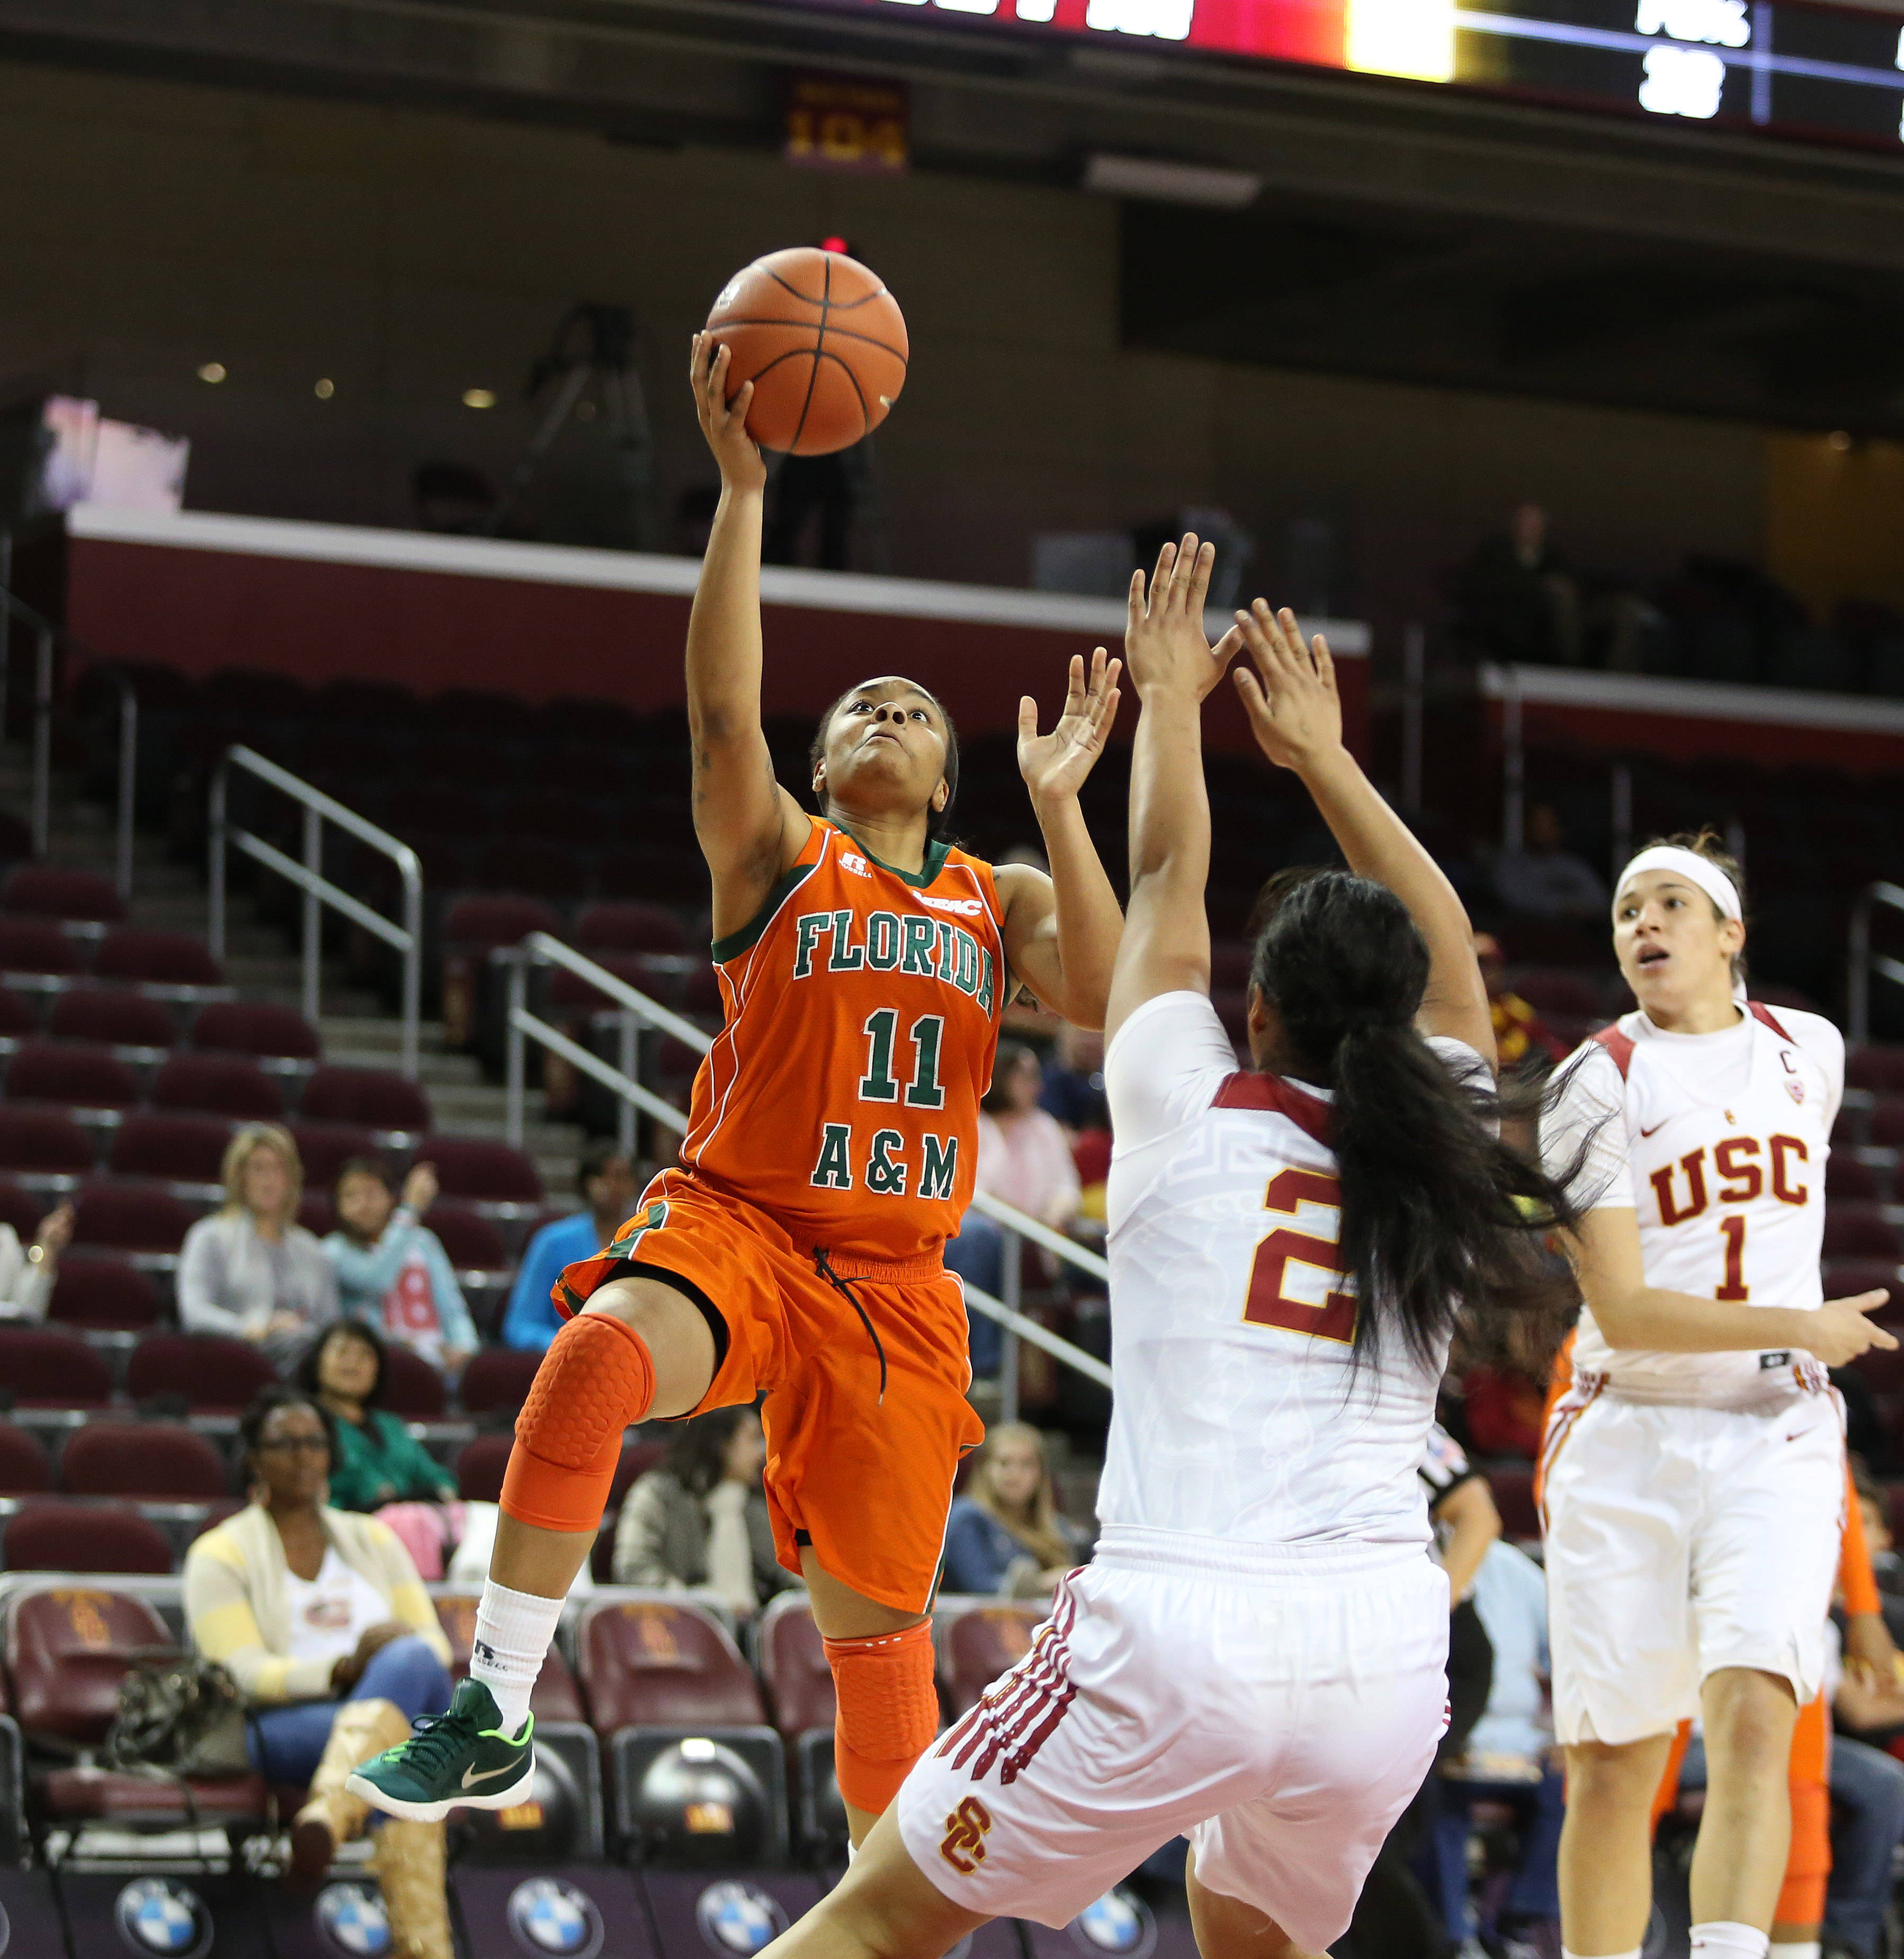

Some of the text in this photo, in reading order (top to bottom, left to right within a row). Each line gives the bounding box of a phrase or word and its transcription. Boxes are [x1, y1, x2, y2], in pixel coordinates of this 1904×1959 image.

[838, 859, 873, 878] RUSSELL
[793, 909, 994, 1023] FLORIDA
[858, 1007, 946, 1110] 11
[1780, 1050, 1797, 1074] C
[1649, 1133, 1809, 1227] USC
[1241, 1167, 1359, 1346] 2
[1715, 1214, 1749, 1303] 1
